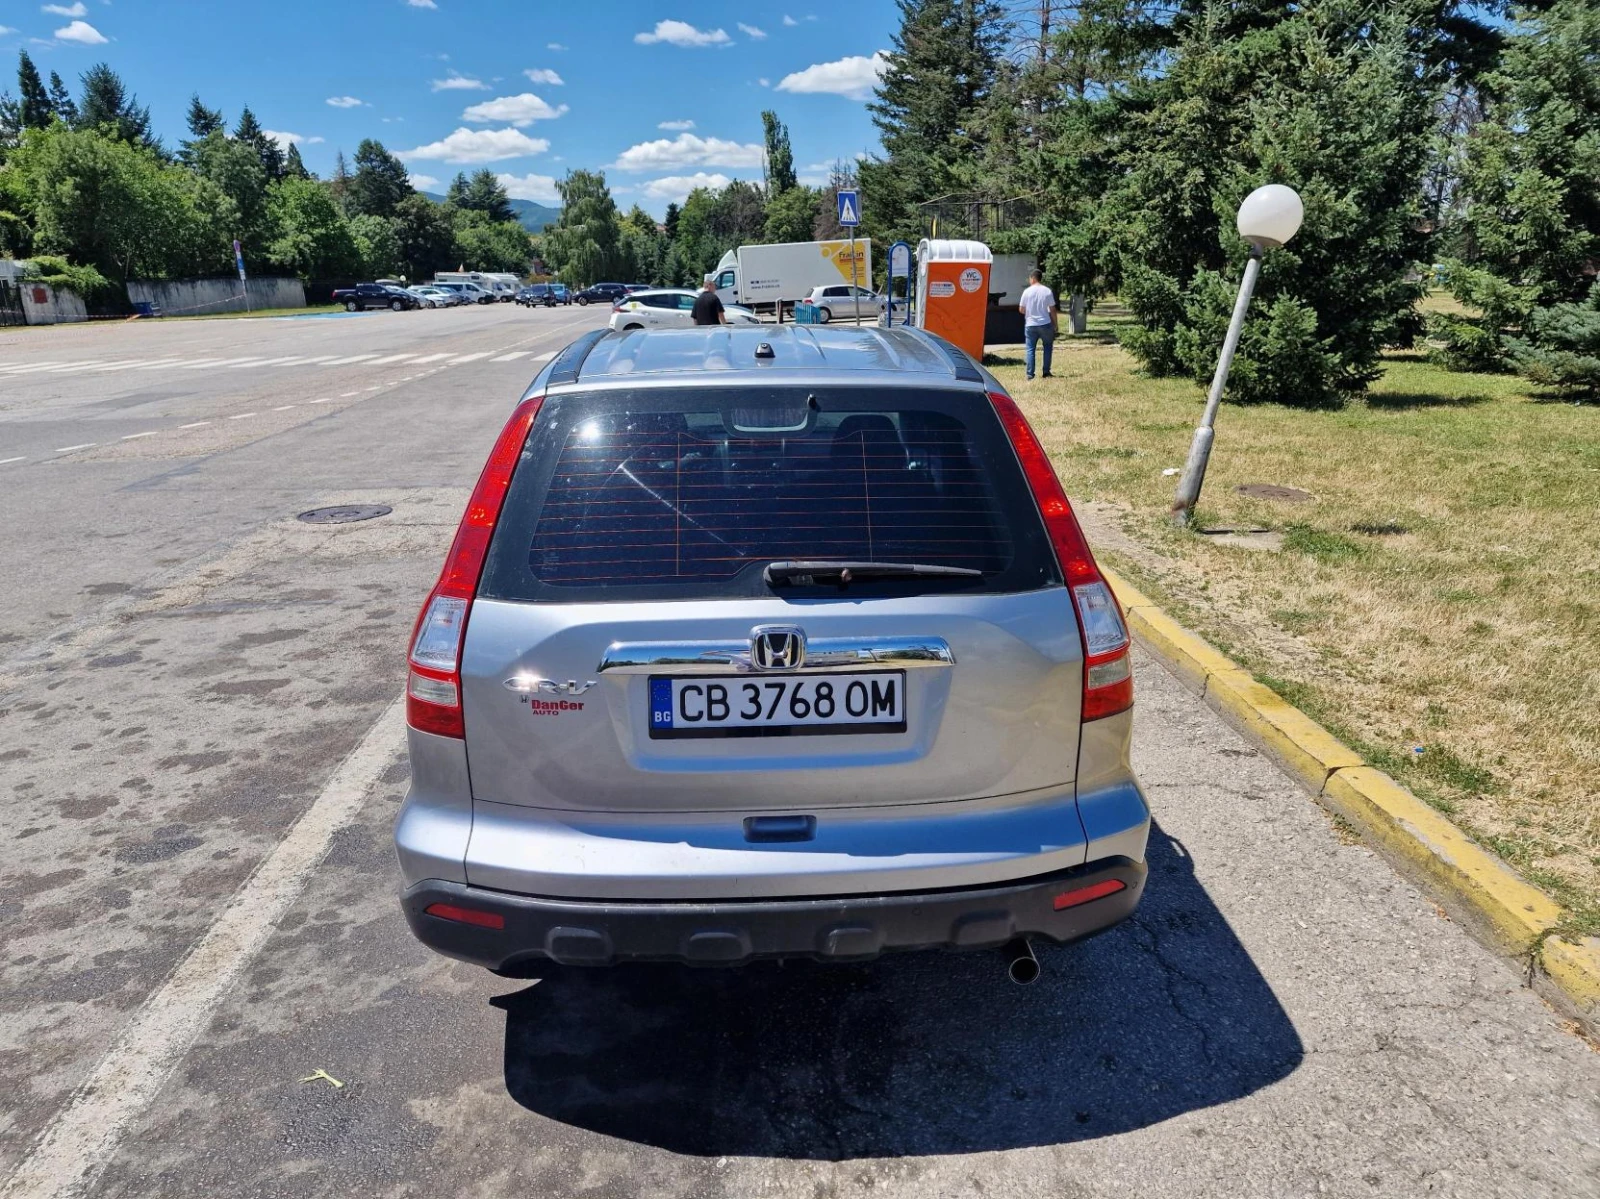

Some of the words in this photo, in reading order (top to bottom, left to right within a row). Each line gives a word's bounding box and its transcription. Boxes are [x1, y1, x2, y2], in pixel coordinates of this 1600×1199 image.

[502, 676, 598, 695] CR-V
[531, 699, 585, 711] DanGer
[679, 684, 731, 722] CB
[740, 681, 835, 720] 3768
[845, 680, 895, 717] OM
[654, 711, 671, 723] BG
